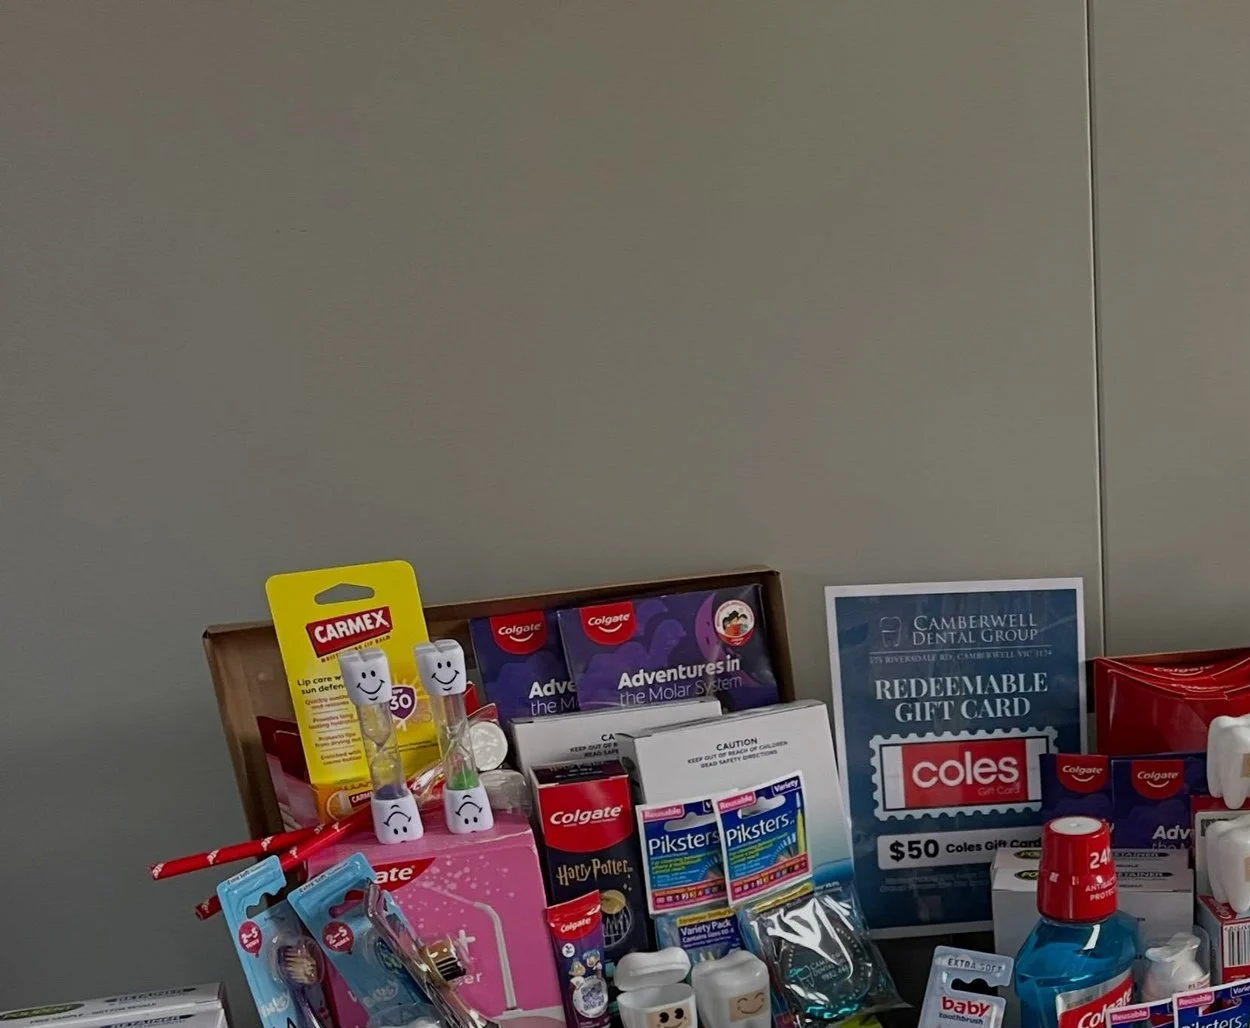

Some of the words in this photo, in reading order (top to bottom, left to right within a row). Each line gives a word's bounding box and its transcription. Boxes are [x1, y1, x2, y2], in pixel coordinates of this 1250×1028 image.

[313, 609, 391, 644] CARMEX
[588, 611, 631, 627] Colgate
[913, 612, 1038, 632] CAMBERWELL
[498, 622, 542, 638] Colgate
[912, 629, 976, 646] DENTAL
[980, 627, 1038, 644] GROUP
[312, 676, 333, 685] care
[617, 661, 722, 690] Adventures
[726, 655, 740, 672] in
[620, 691, 646, 706] the
[649, 681, 692, 703] Molar
[695, 674, 742, 698] System
[875, 672, 1048, 700] REDEEMABLE
[894, 701, 954, 723] GIFT
[960, 697, 1031, 720] CARD
[716, 737, 758, 751] CAUTION
[911, 751, 1020, 788] coles
[1062, 764, 1104, 776] Colgate
[1136, 770, 1180, 782] Colgate
[773, 779, 799, 794] Variety
[718, 794, 754, 810] Reusable
[549, 805, 622, 826] Colgate
[643, 806, 683, 819] Reusable
[726, 816, 789, 845] Piksters
[648, 827, 720, 855] Piksters
[945, 842, 983, 854] Coles
[889, 838, 940, 862] $50
[556, 858, 591, 886] Harry
[592, 856, 629, 879] Potter
[560, 916, 591, 933] Colgate
[680, 922, 709, 935] Variety
[711, 918, 731, 931] Pack
[947, 958, 977, 970] EXTRA
[941, 997, 991, 1017] baby
[938, 1012, 984, 1025] toothbrush
[1111, 1010, 1148, 1022] Reusable
